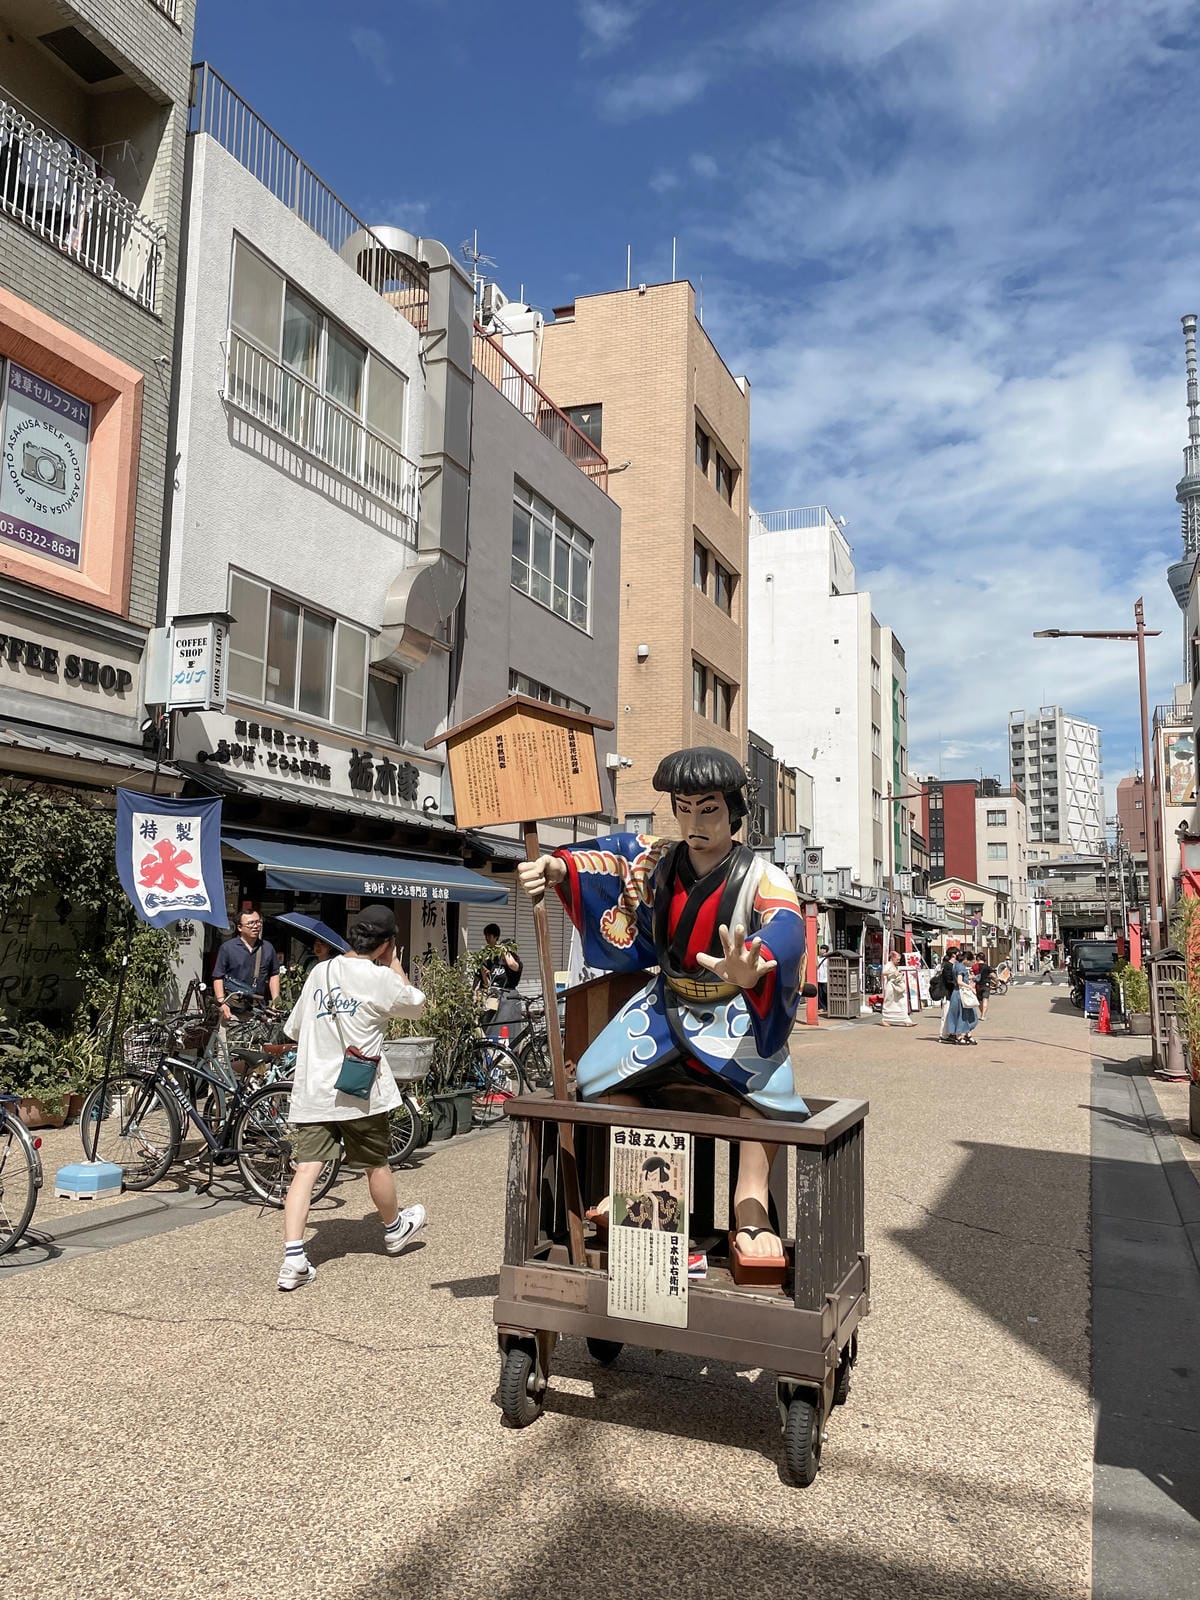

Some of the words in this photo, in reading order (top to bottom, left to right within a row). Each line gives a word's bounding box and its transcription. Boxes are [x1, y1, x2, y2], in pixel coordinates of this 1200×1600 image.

[10, 371, 87, 421] 浅草セルフフォト
[8, 418, 41, 451] ASAKUSA
[43, 421, 65, 441] SELF
[64, 442, 81, 482] PHOTO
[6, 453, 26, 496] PHOTO
[24, 496, 48, 514] SELF
[51, 484, 81, 516] ASAKUSA
[0, 518, 77, 560] 03-6322-8631
[176, 637, 208, 648] COFFEE
[180, 648, 203, 658] SHOP
[215, 628, 223, 666] COFFEE
[64, 654, 133, 693] SHOP
[213, 668, 221, 697] SHOP
[139, 819, 194, 842] 特製
[138, 838, 200, 893] 氷
[614, 1129, 686, 1151] 白浪五人男
